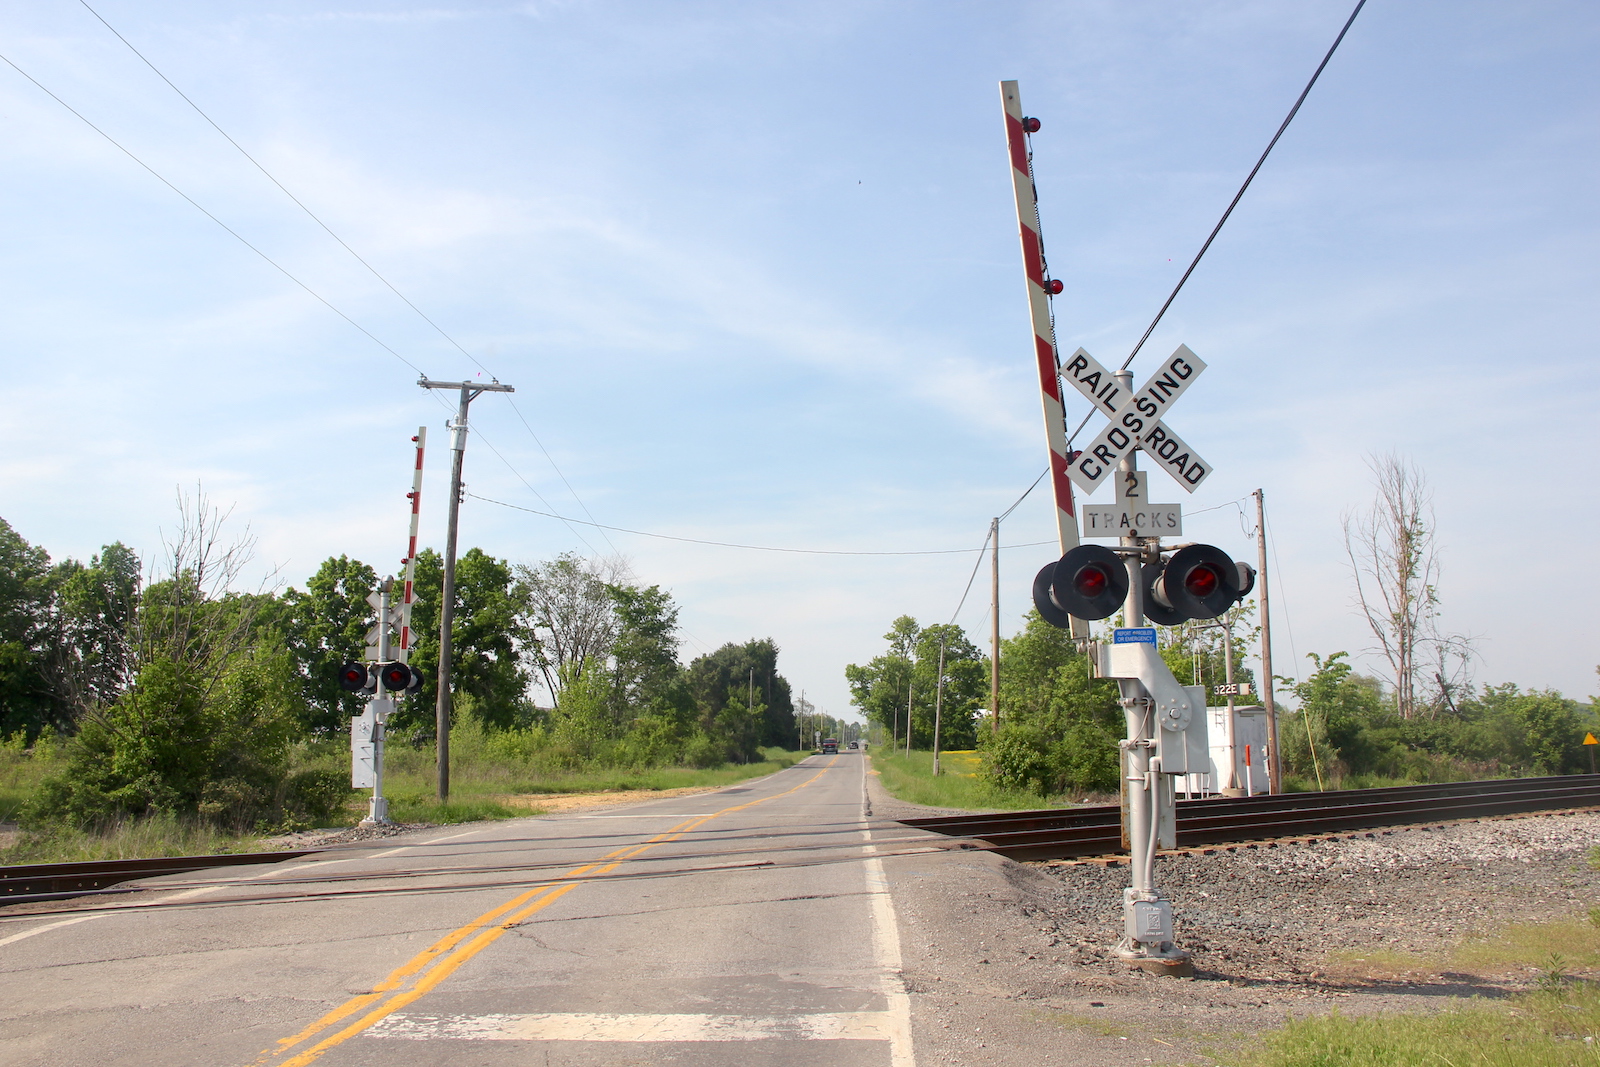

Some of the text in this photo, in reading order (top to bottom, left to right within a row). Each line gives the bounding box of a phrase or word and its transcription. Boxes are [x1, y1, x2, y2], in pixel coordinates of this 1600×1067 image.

[1066, 354, 1205, 485] RAIL ROAD
[1079, 357, 1193, 481] CROSSING
[1125, 477, 1139, 498] 2
[1088, 512, 1177, 529] TRACKS
[1214, 684, 1238, 694] 322E
